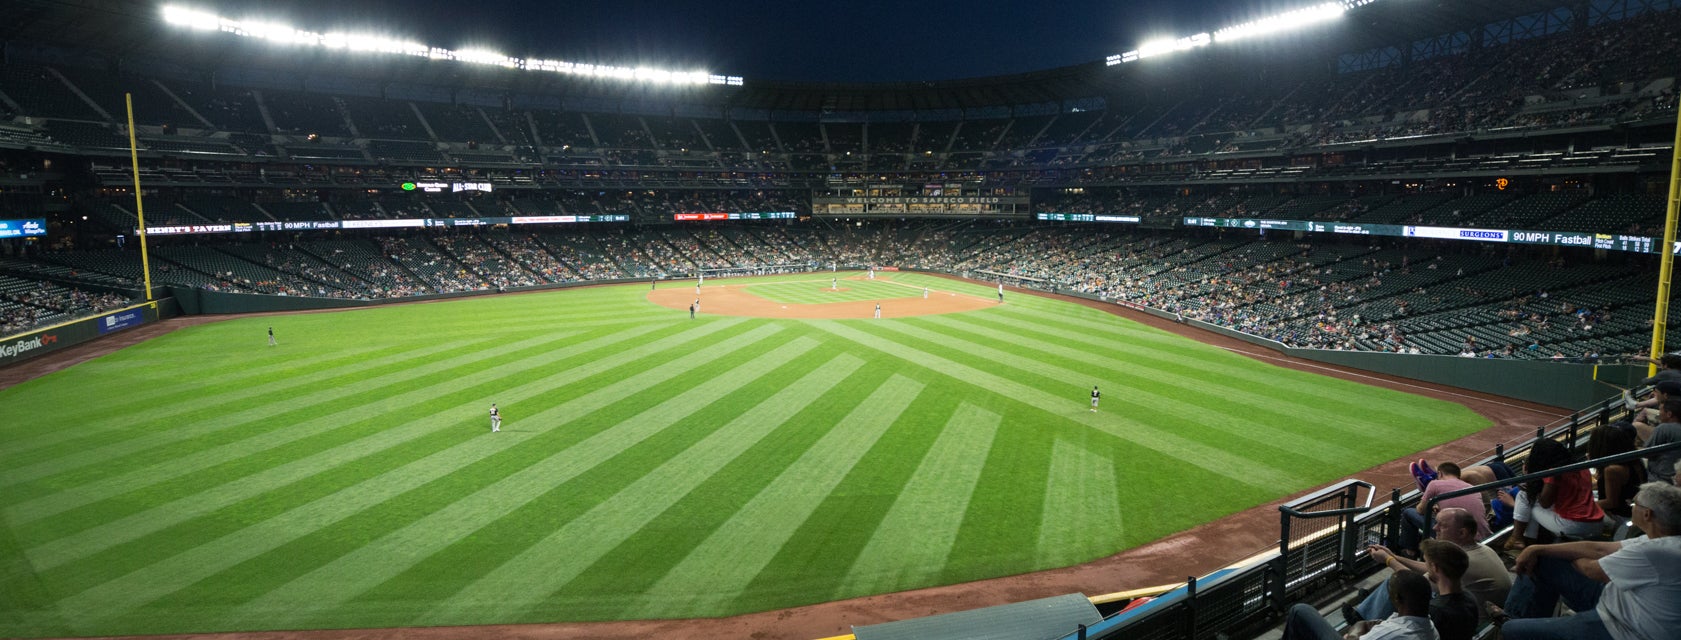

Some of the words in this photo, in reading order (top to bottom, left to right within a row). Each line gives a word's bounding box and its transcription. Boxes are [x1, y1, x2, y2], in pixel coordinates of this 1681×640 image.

[146, 226, 190, 234] HENRY'S
[1513, 232, 1525, 241] 90
[1526, 232, 1549, 243] MPH
[1554, 234, 1592, 245] Fastball
[0, 337, 42, 358] KeyBank
